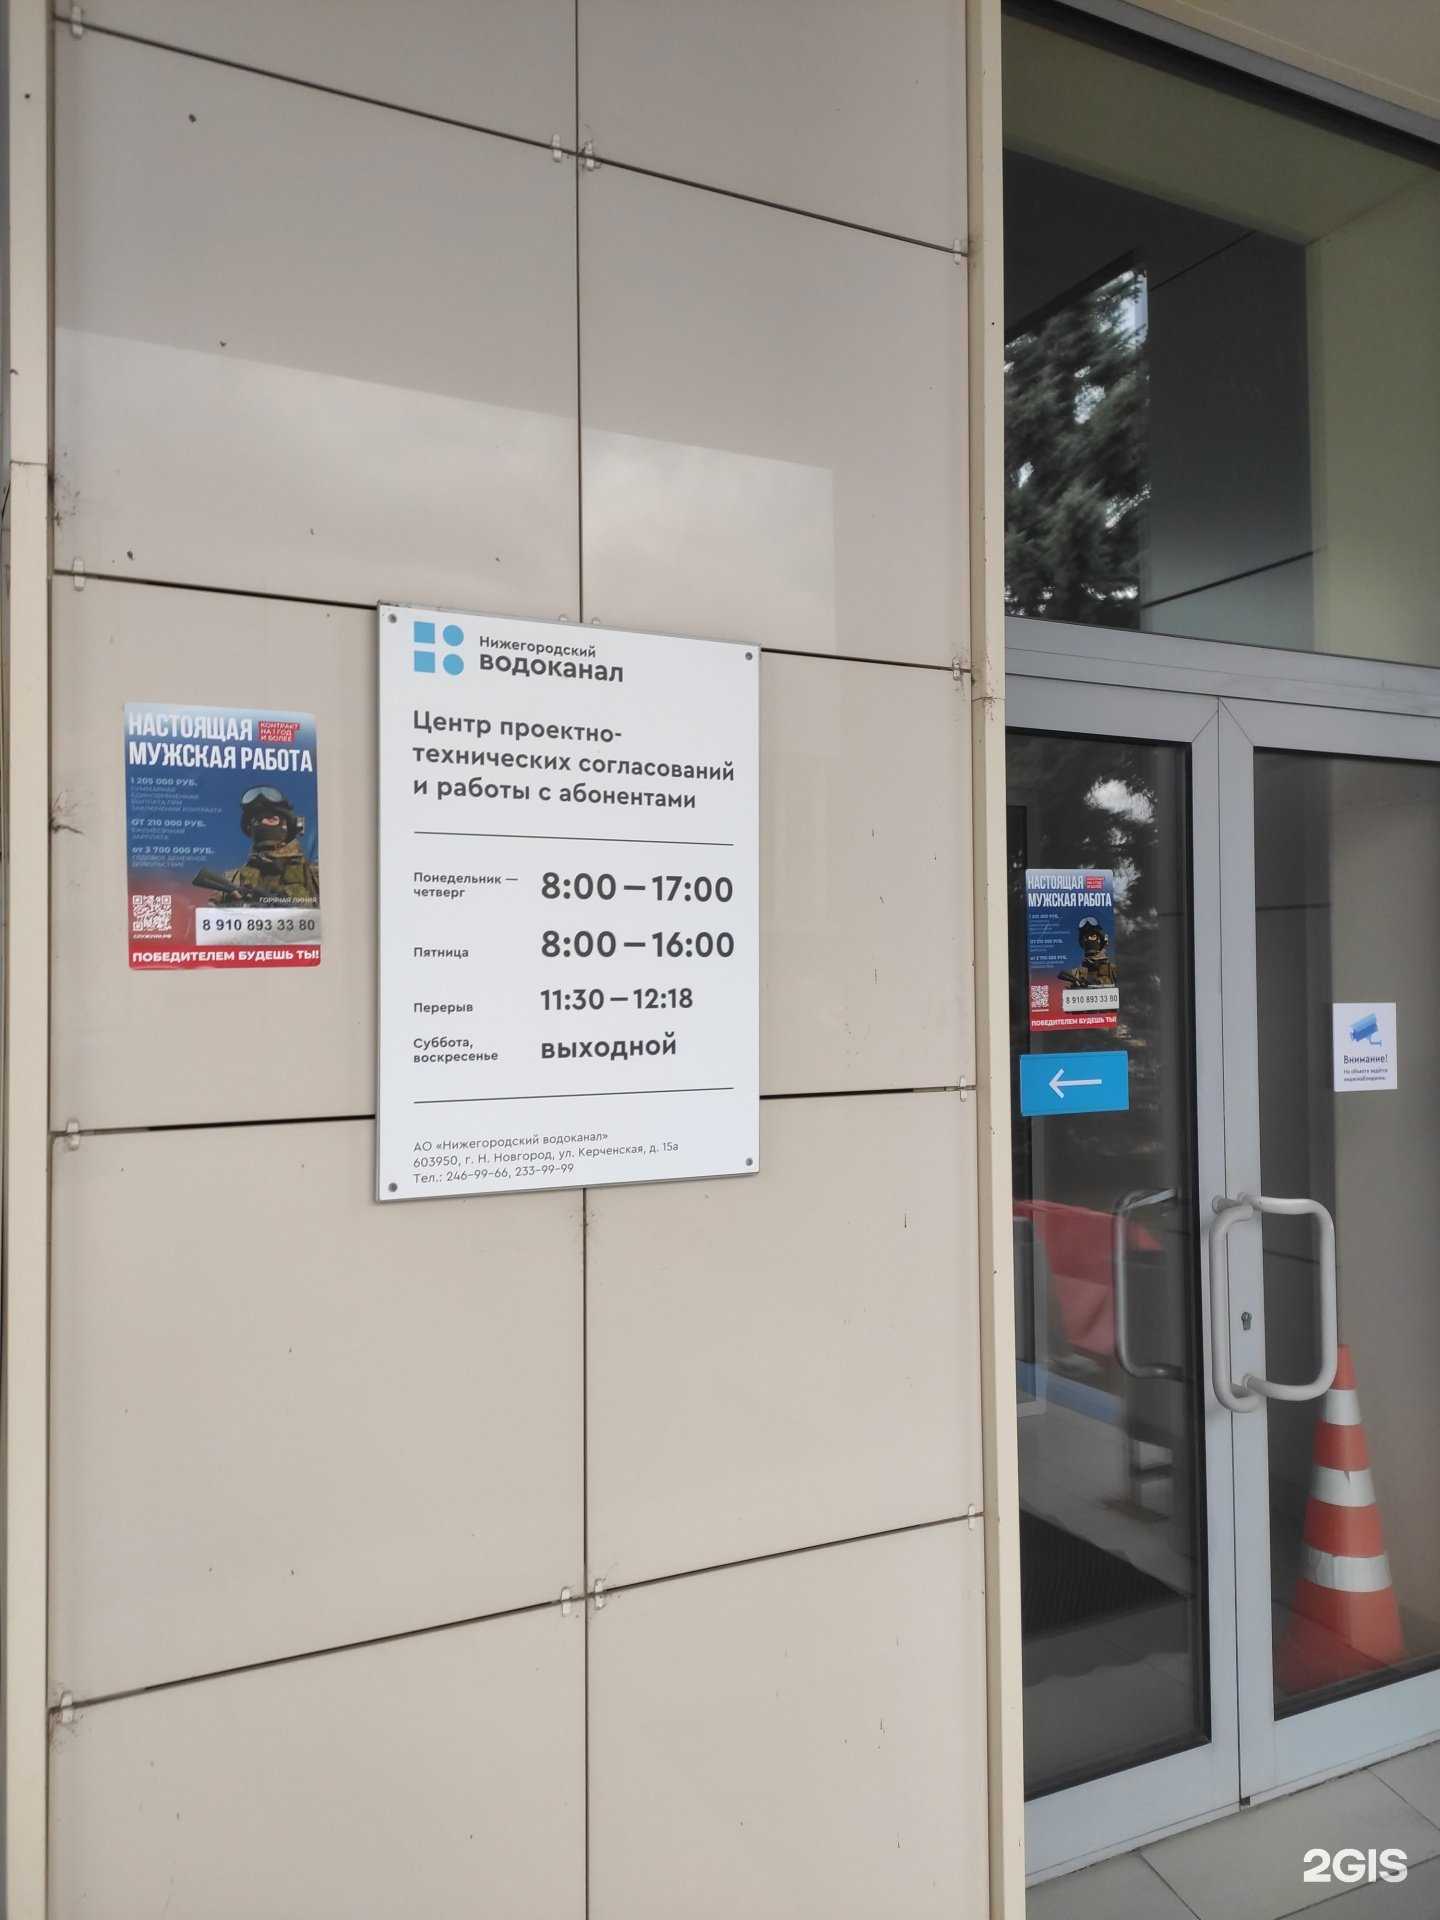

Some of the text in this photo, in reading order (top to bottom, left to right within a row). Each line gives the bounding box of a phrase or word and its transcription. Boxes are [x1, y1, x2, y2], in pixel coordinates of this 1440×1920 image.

[479, 636, 596, 658] Нижегородский
[479, 653, 624, 682] водоканал
[128, 712, 253, 742] НАСТОЯЩАЯ
[413, 710, 622, 743] Центр проектно-
[129, 741, 313, 772] МУЖСКАЯ РАБОТА
[412, 746, 735, 781] технических согласований
[413, 776, 696, 809] и работы с абонентами
[414, 872, 502, 885] Понедельник
[541, 872, 616, 900] 8:00
[651, 875, 733, 902] 17:00
[1028, 875, 1084, 890] НАСТОЯЩАЯ
[414, 888, 465, 900] четверг
[1028, 892, 1112, 907] МУЖСКАЯ РАБОТА
[202, 919, 315, 931] 8 910 893 33 80
[414, 947, 469, 959] Пятница
[541, 930, 616, 957] 8:00
[651, 932, 734, 957] 16:00
[132, 949, 320, 963] ПОБЕДИТЕЛЕМ БУДЕШЬ ТЫ!
[414, 1002, 473, 1015] Перерыв
[540, 988, 604, 1010] 11:30
[633, 988, 693, 1009] 12:18
[1072, 996, 1084, 1004] 910
[1032, 1018, 1078, 1026] ПОБЕДИТЕЛЕМ
[414, 1036, 473, 1051] Суббота,
[541, 1031, 676, 1060] выходной
[414, 1052, 499, 1064] воскресенье
[1344, 1054, 1388, 1064] Внимание!
[413, 1133, 608, 1152] АО «Нижегородский водоканал»
[413, 1142, 679, 1168] 603950, г. Н. Новгород, ул. Керченская, д. 15а
[413, 1163, 574, 1184] Тел.: 246-99-66, 233-99-99
